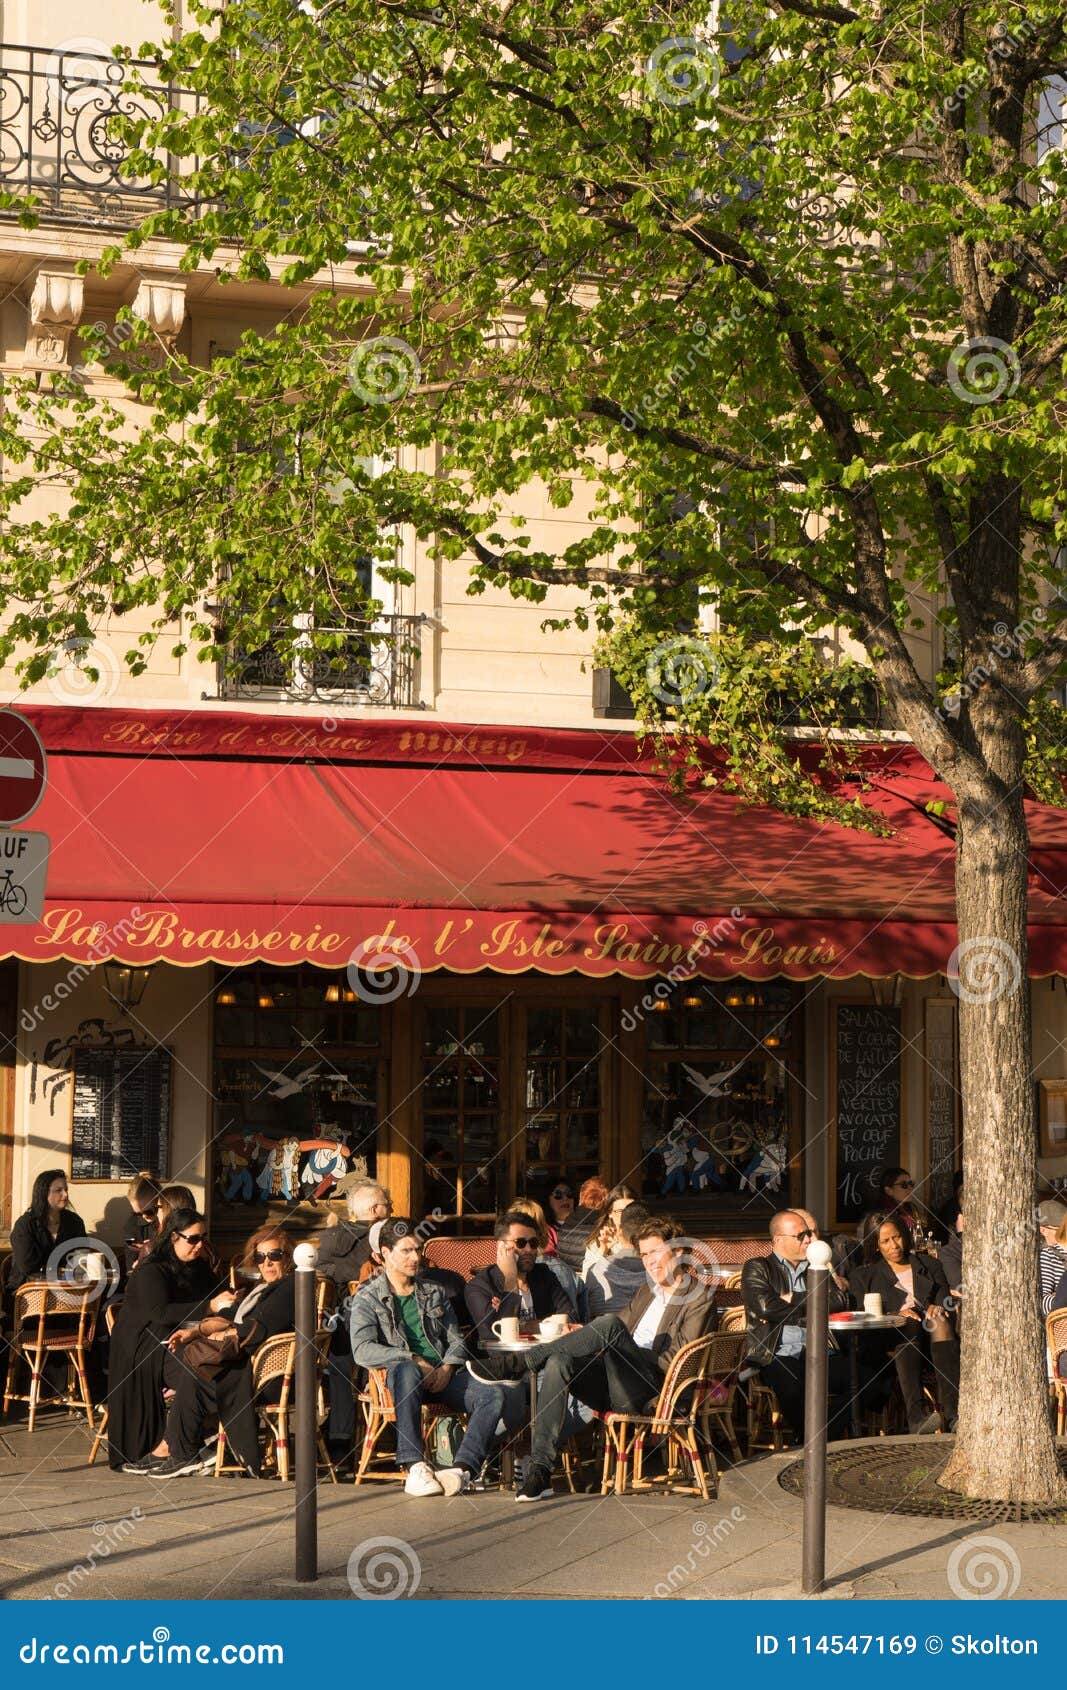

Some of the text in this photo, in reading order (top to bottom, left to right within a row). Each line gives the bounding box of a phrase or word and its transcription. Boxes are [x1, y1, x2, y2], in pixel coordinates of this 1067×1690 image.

[0, 837, 28, 858] UF
[34, 908, 112, 946] La
[126, 910, 351, 953] Brasserie
[363, 919, 420, 954] de
[842, 1098, 894, 1112] VERTES
[838, 1112, 898, 1128] AVOCATS
[839, 1128, 857, 1143] ET
[838, 1171, 863, 1206] 16
